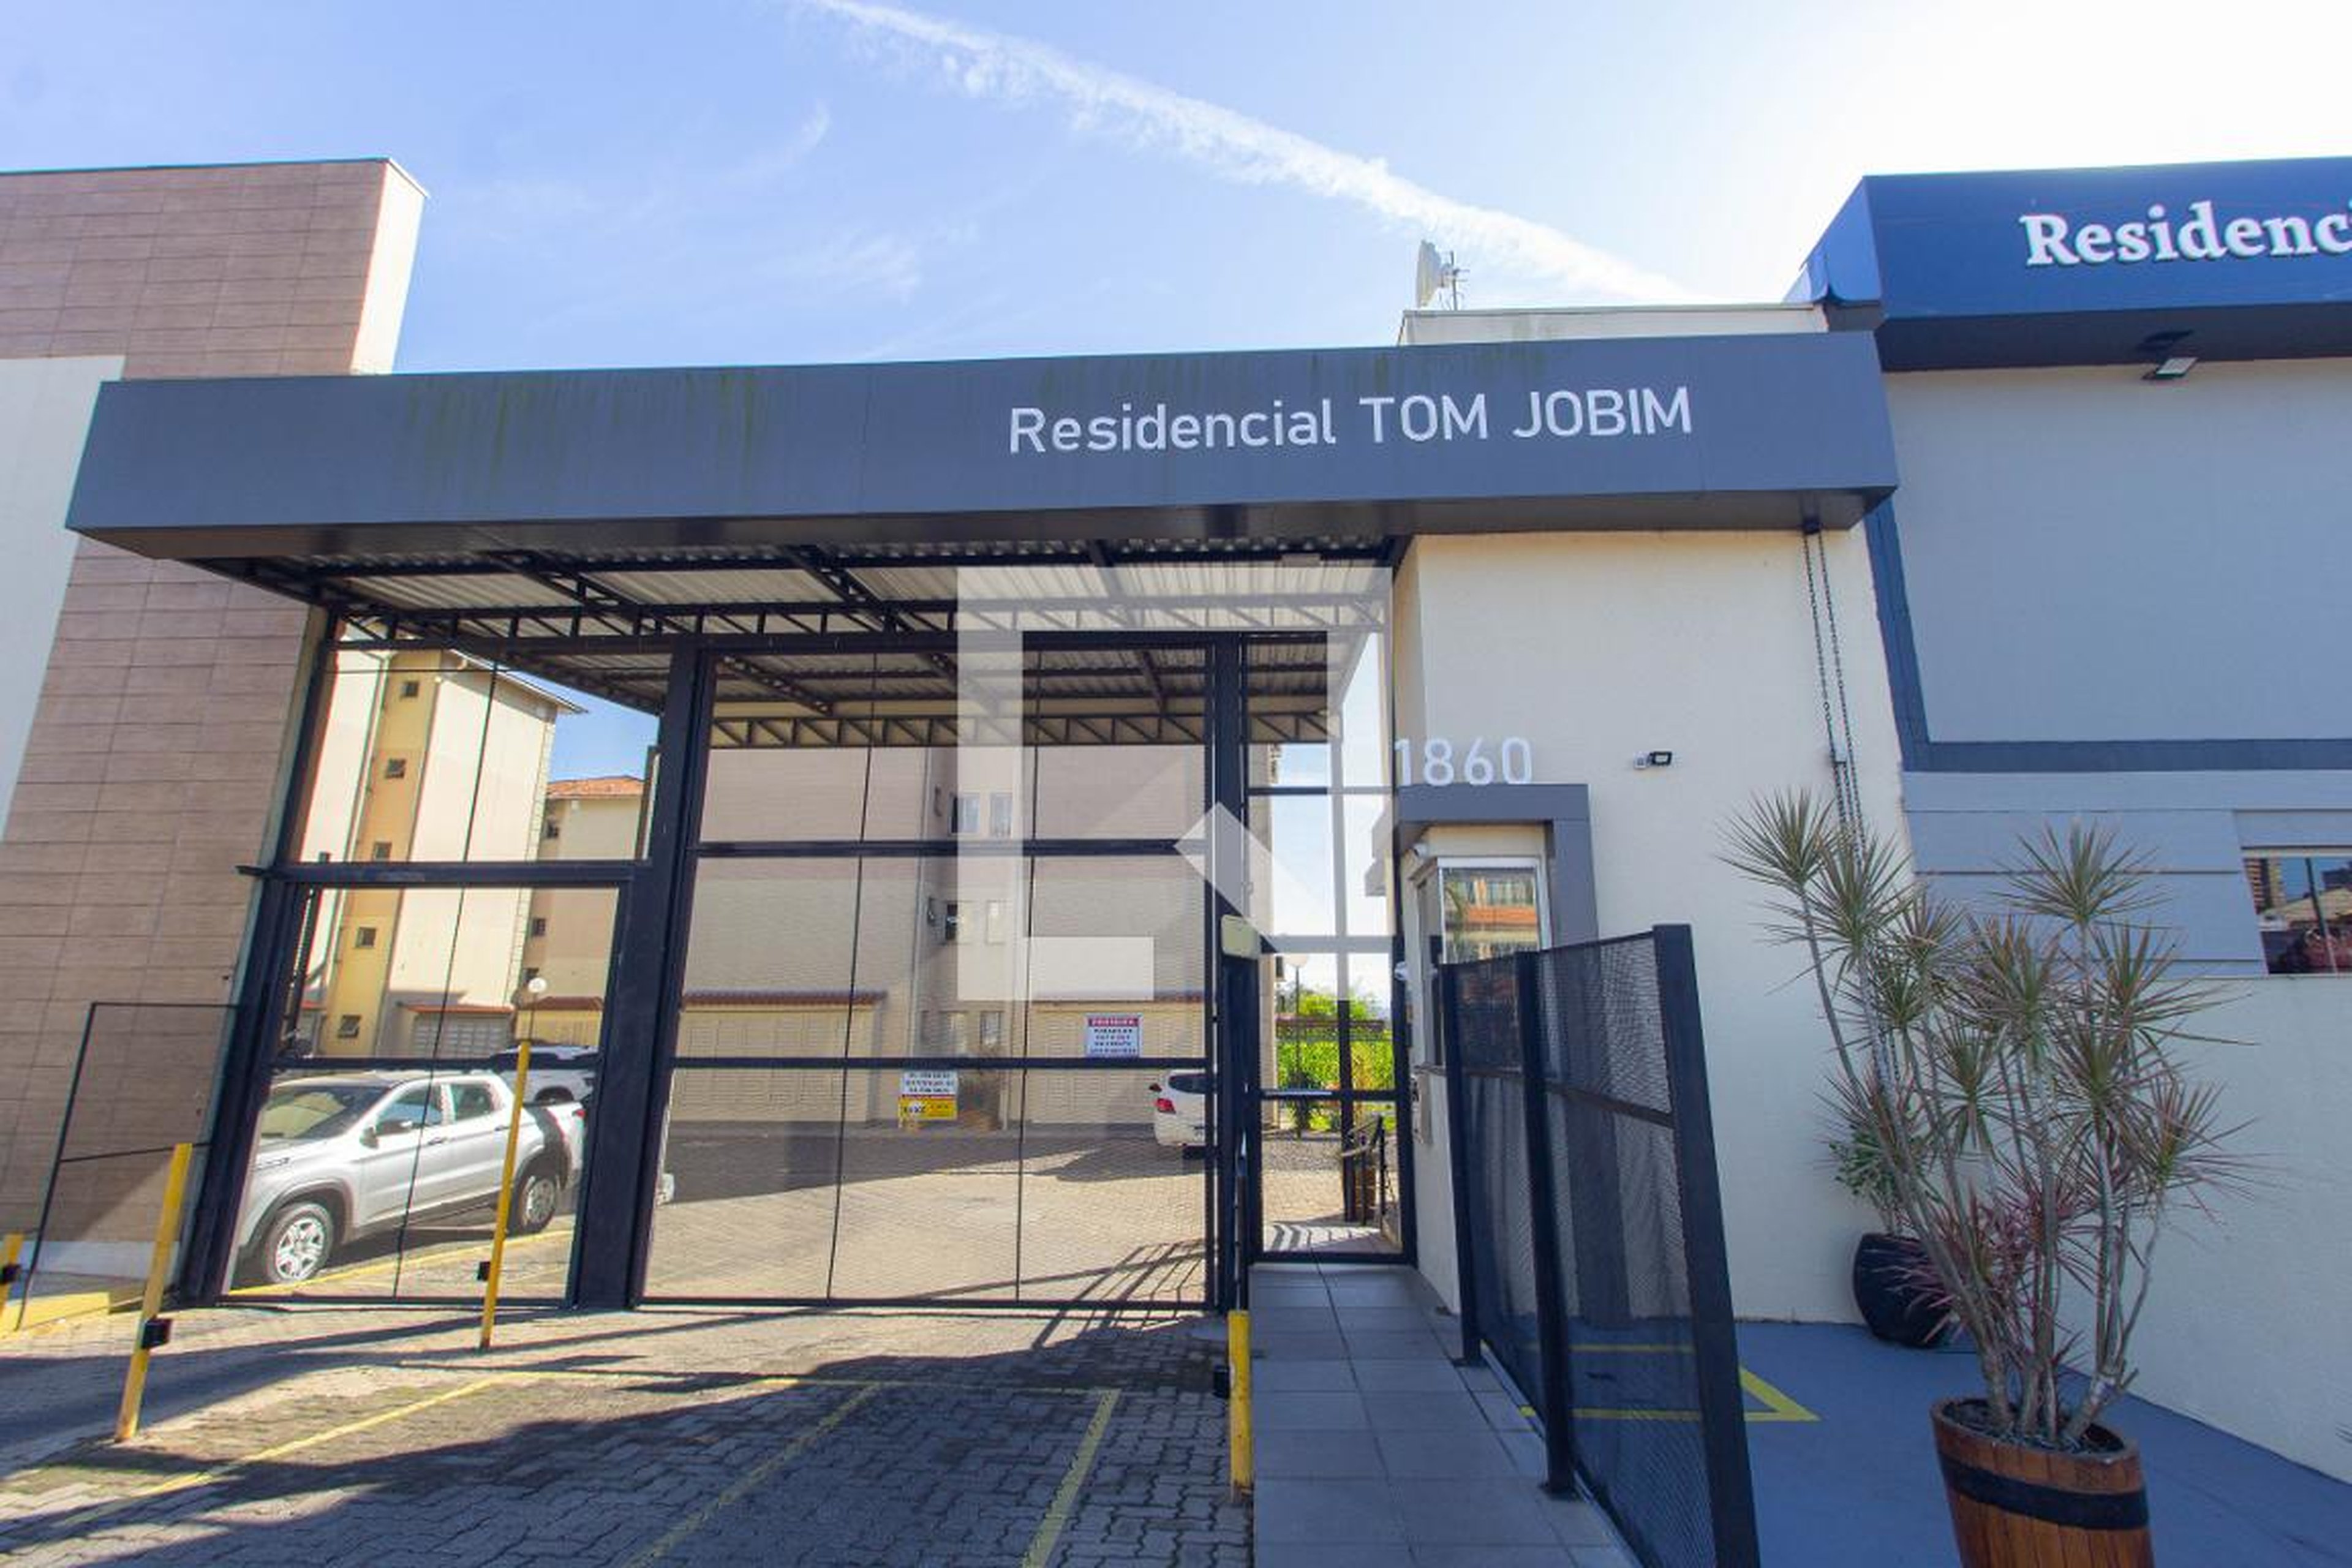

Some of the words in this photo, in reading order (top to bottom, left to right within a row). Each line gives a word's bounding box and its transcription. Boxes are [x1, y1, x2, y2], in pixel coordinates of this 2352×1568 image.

[2019, 200, 2352, 266] Residenc
[1009, 398, 1336, 454] Residencial
[1359, 393, 1488, 443] TOM
[1512, 386, 1692, 438] JOBIM
[1395, 737, 1532, 786] 1860
